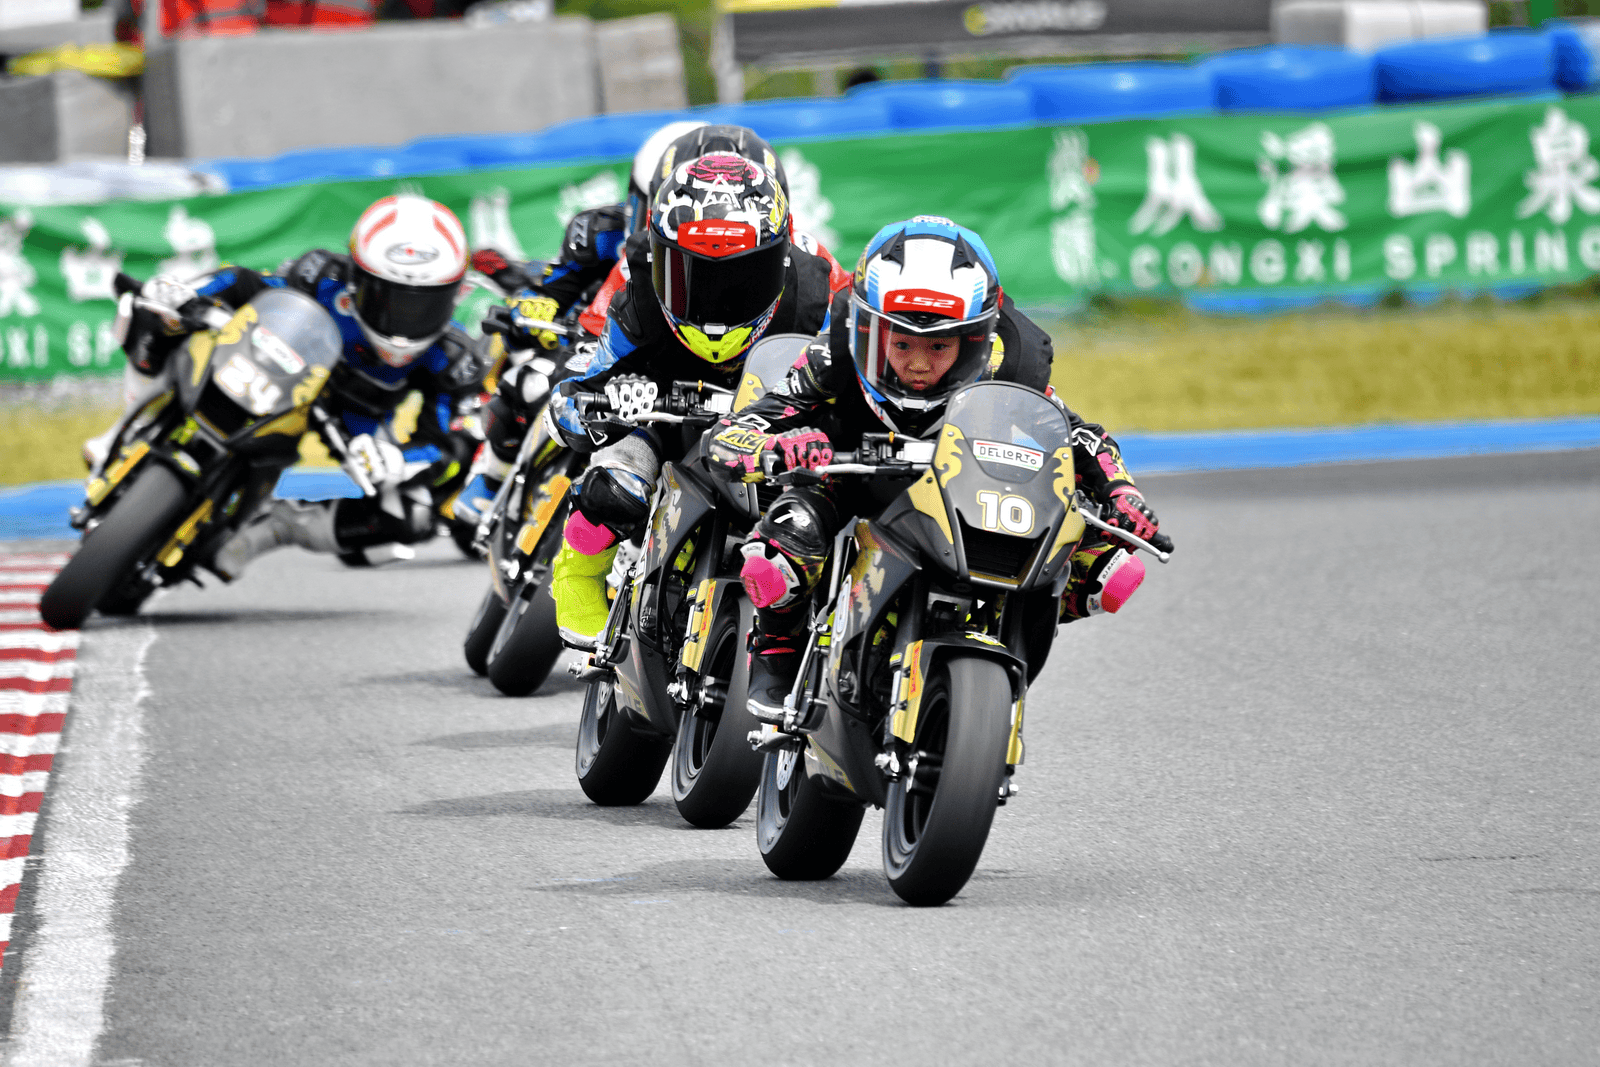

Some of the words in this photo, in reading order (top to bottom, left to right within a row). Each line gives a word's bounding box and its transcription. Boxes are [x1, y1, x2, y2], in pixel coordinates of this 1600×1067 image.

[688, 227, 746, 237] LS2
[1129, 240, 1351, 288] CONGXI
[893, 295, 956, 308] LS2
[0, 324, 49, 368] XI
[214, 352, 283, 416] 24
[979, 446, 1037, 465] DELLORTO
[976, 490, 1035, 536] 10
